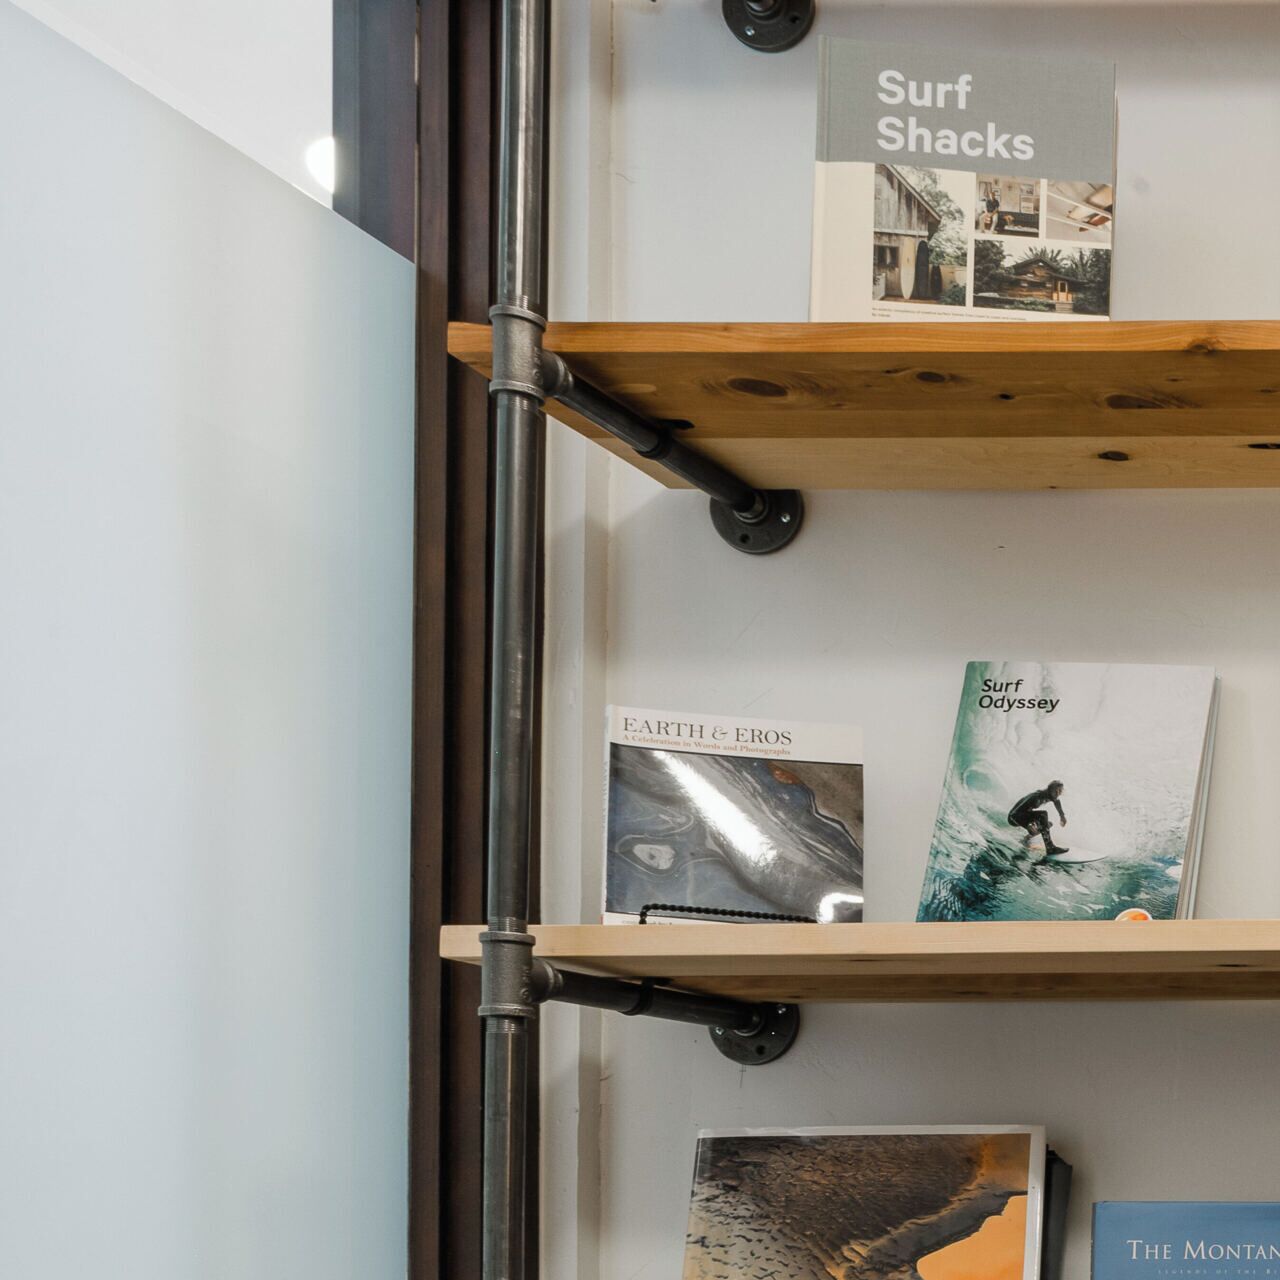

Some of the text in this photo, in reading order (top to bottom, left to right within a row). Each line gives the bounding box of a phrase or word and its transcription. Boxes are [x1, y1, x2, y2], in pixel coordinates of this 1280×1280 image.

[877, 69, 973, 110] Surf
[876, 116, 1035, 161] Shacks
[981, 679, 1024, 693] Surf
[979, 695, 1060, 713] Odyssey
[624, 717, 792, 746] EARTH & EROS
